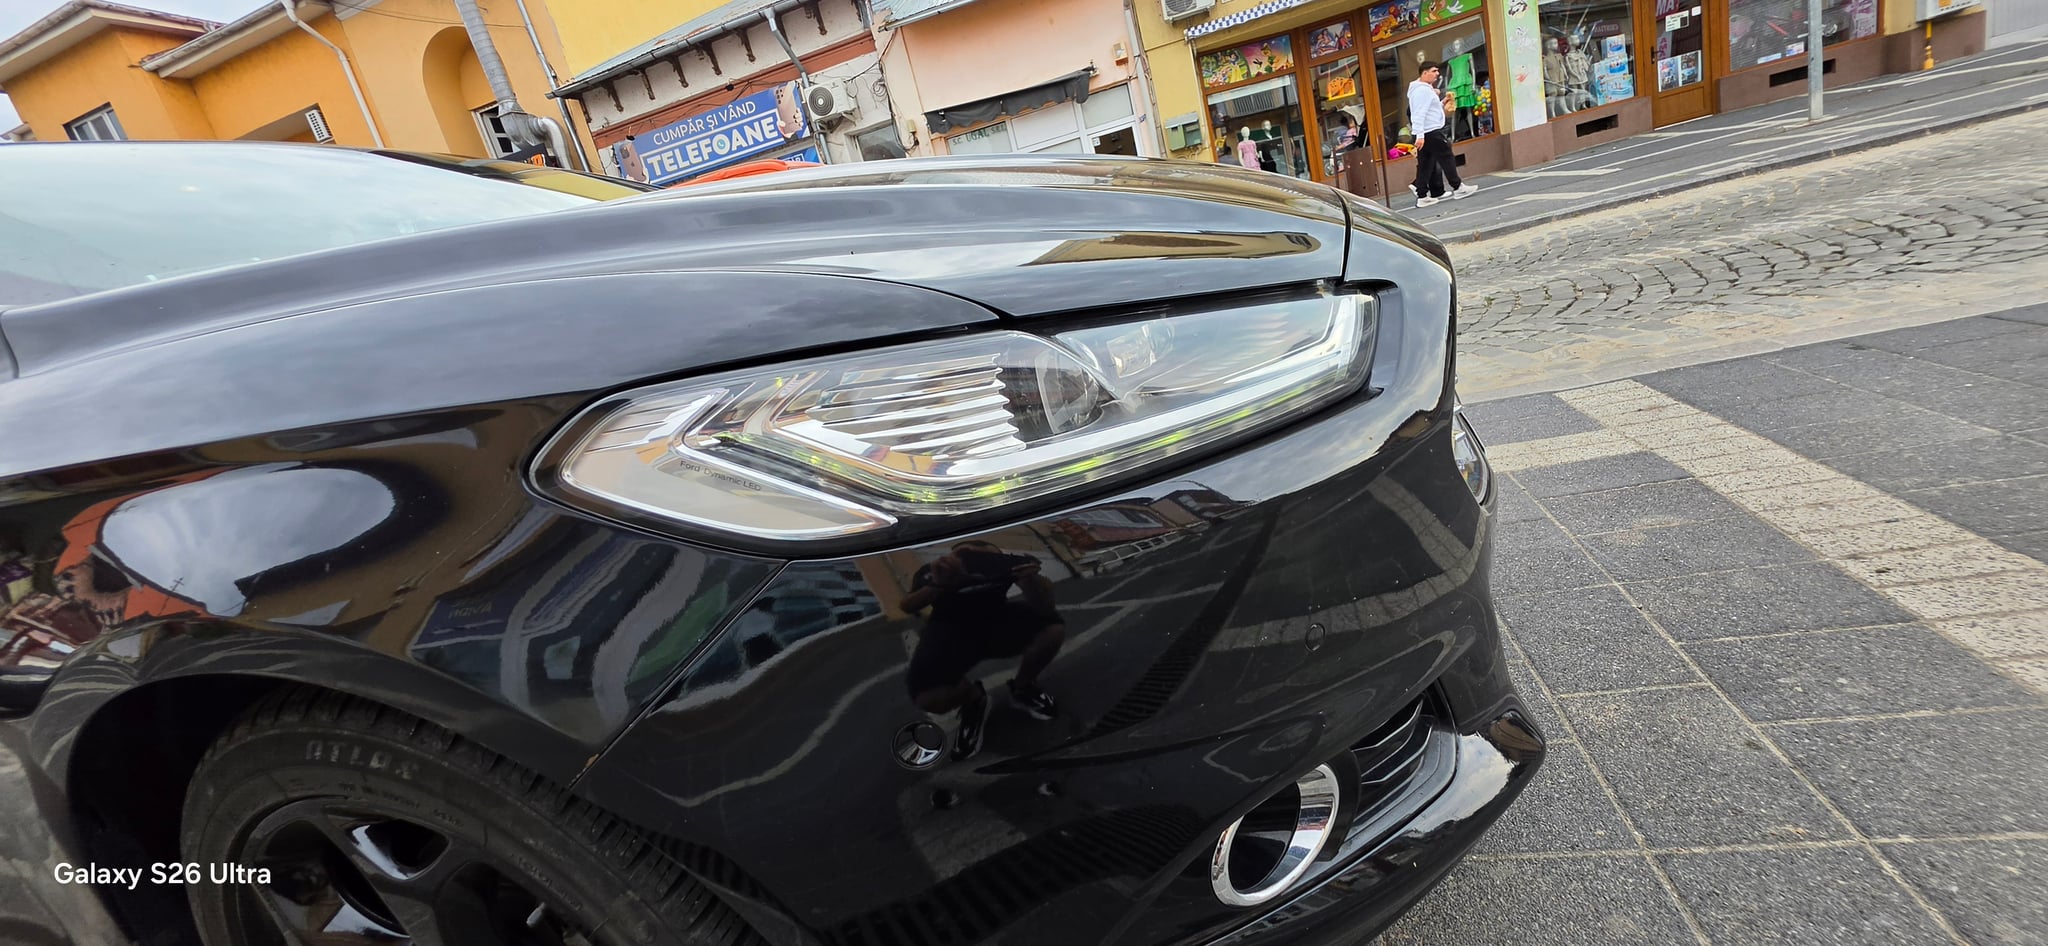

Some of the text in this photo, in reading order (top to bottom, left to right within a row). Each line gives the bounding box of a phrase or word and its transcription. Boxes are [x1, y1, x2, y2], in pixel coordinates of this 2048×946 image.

[653, 119, 704, 145] CUMPĂR
[718, 101, 756, 124] VÂND
[647, 116, 778, 177] TELEFOANE
[680, 460, 762, 492] Ford Dynamic LED
